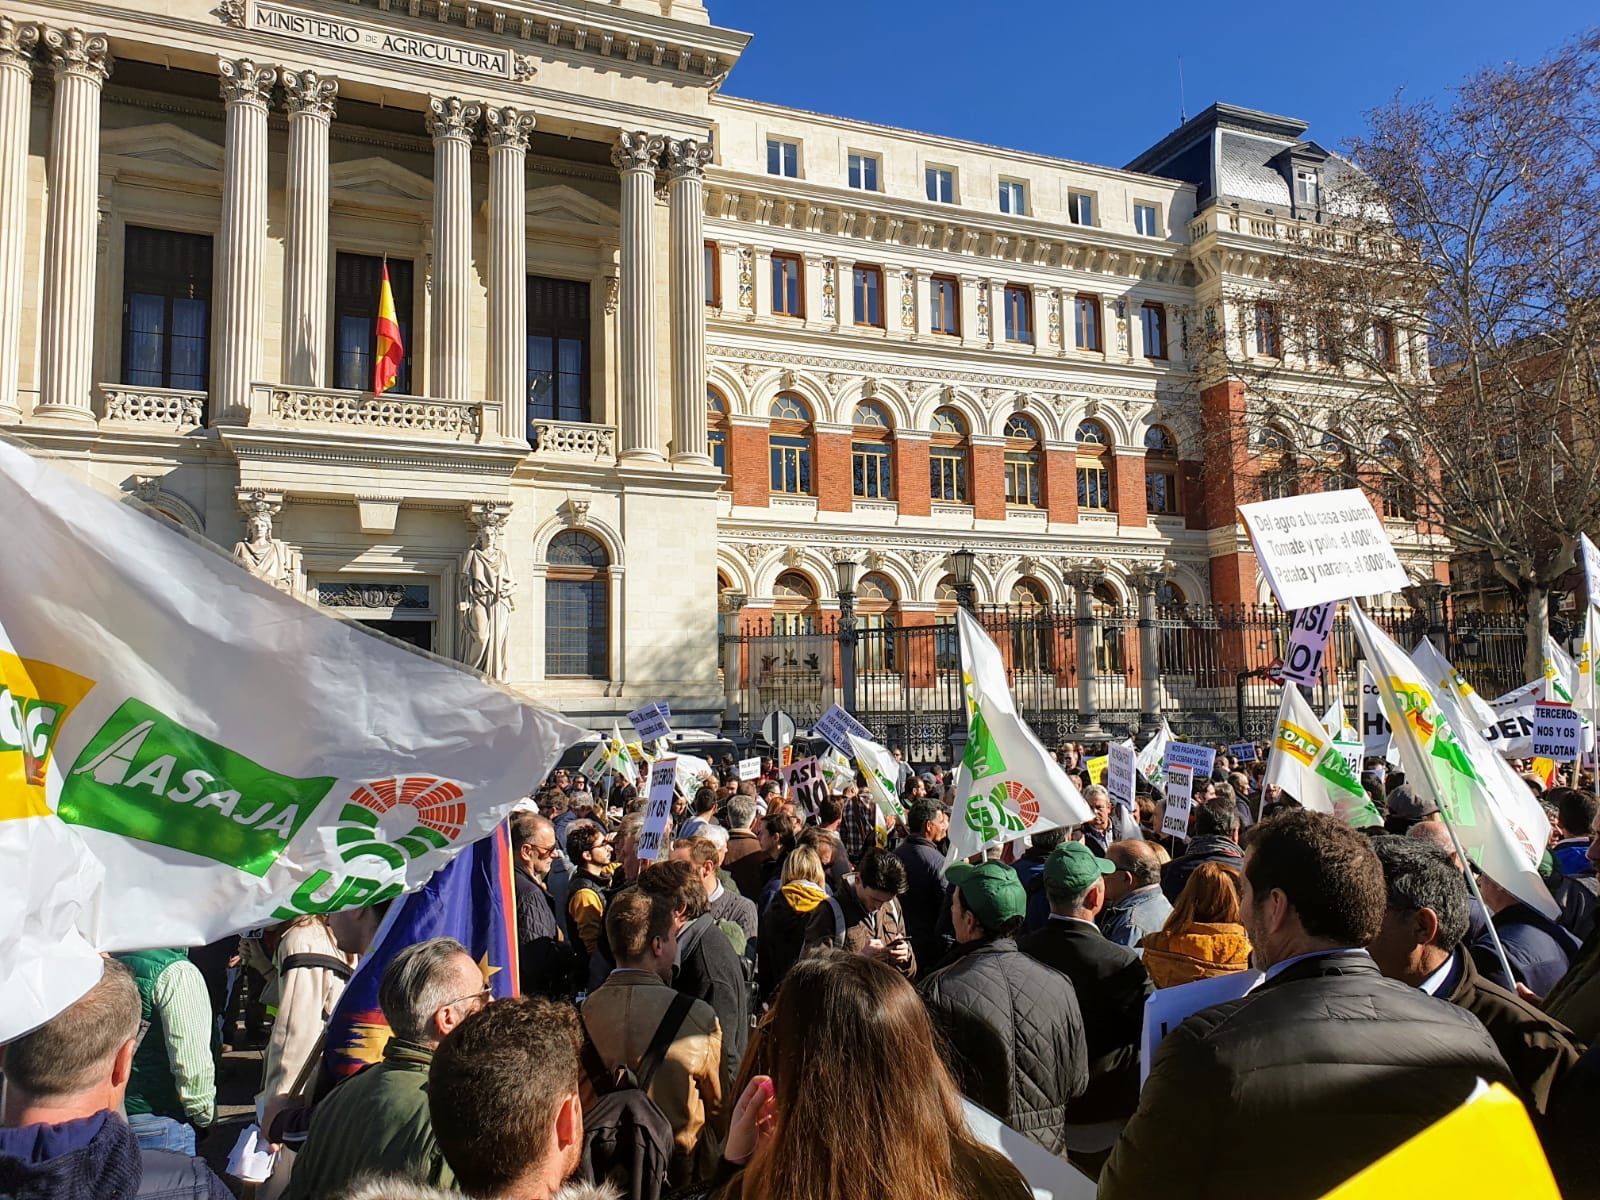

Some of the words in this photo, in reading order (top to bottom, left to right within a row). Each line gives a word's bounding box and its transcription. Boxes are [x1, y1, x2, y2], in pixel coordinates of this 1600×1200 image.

[257, 9, 359, 43] MINISTERIO
[365, 34, 377, 44] DE
[382, 36, 502, 73] AGRICULTURA
[1253, 515, 1273, 532] Del
[1274, 513, 1296, 534] agro
[1299, 515, 1306, 527] a
[1306, 511, 1317, 525] tu
[1317, 511, 1340, 525] casa
[1341, 507, 1374, 522] suben:
[1267, 539, 1307, 556] Tomate
[1306, 540, 1315, 556] y
[1341, 534, 1350, 549] el
[1275, 566, 1308, 583] Patata
[1309, 566, 1317, 583] y
[1354, 558, 1362, 573] el
[1535, 707, 1577, 720] TERCEROS
[1537, 726, 1553, 737] NOS
[1556, 728, 1561, 737] Y
[1563, 728, 1575, 738] OS
[1534, 744, 1577, 756] EXPLOTAN.
[790, 757, 816, 786] ASÍ
[797, 779, 828, 813] NO
[1181, 796, 1187, 810] OS
